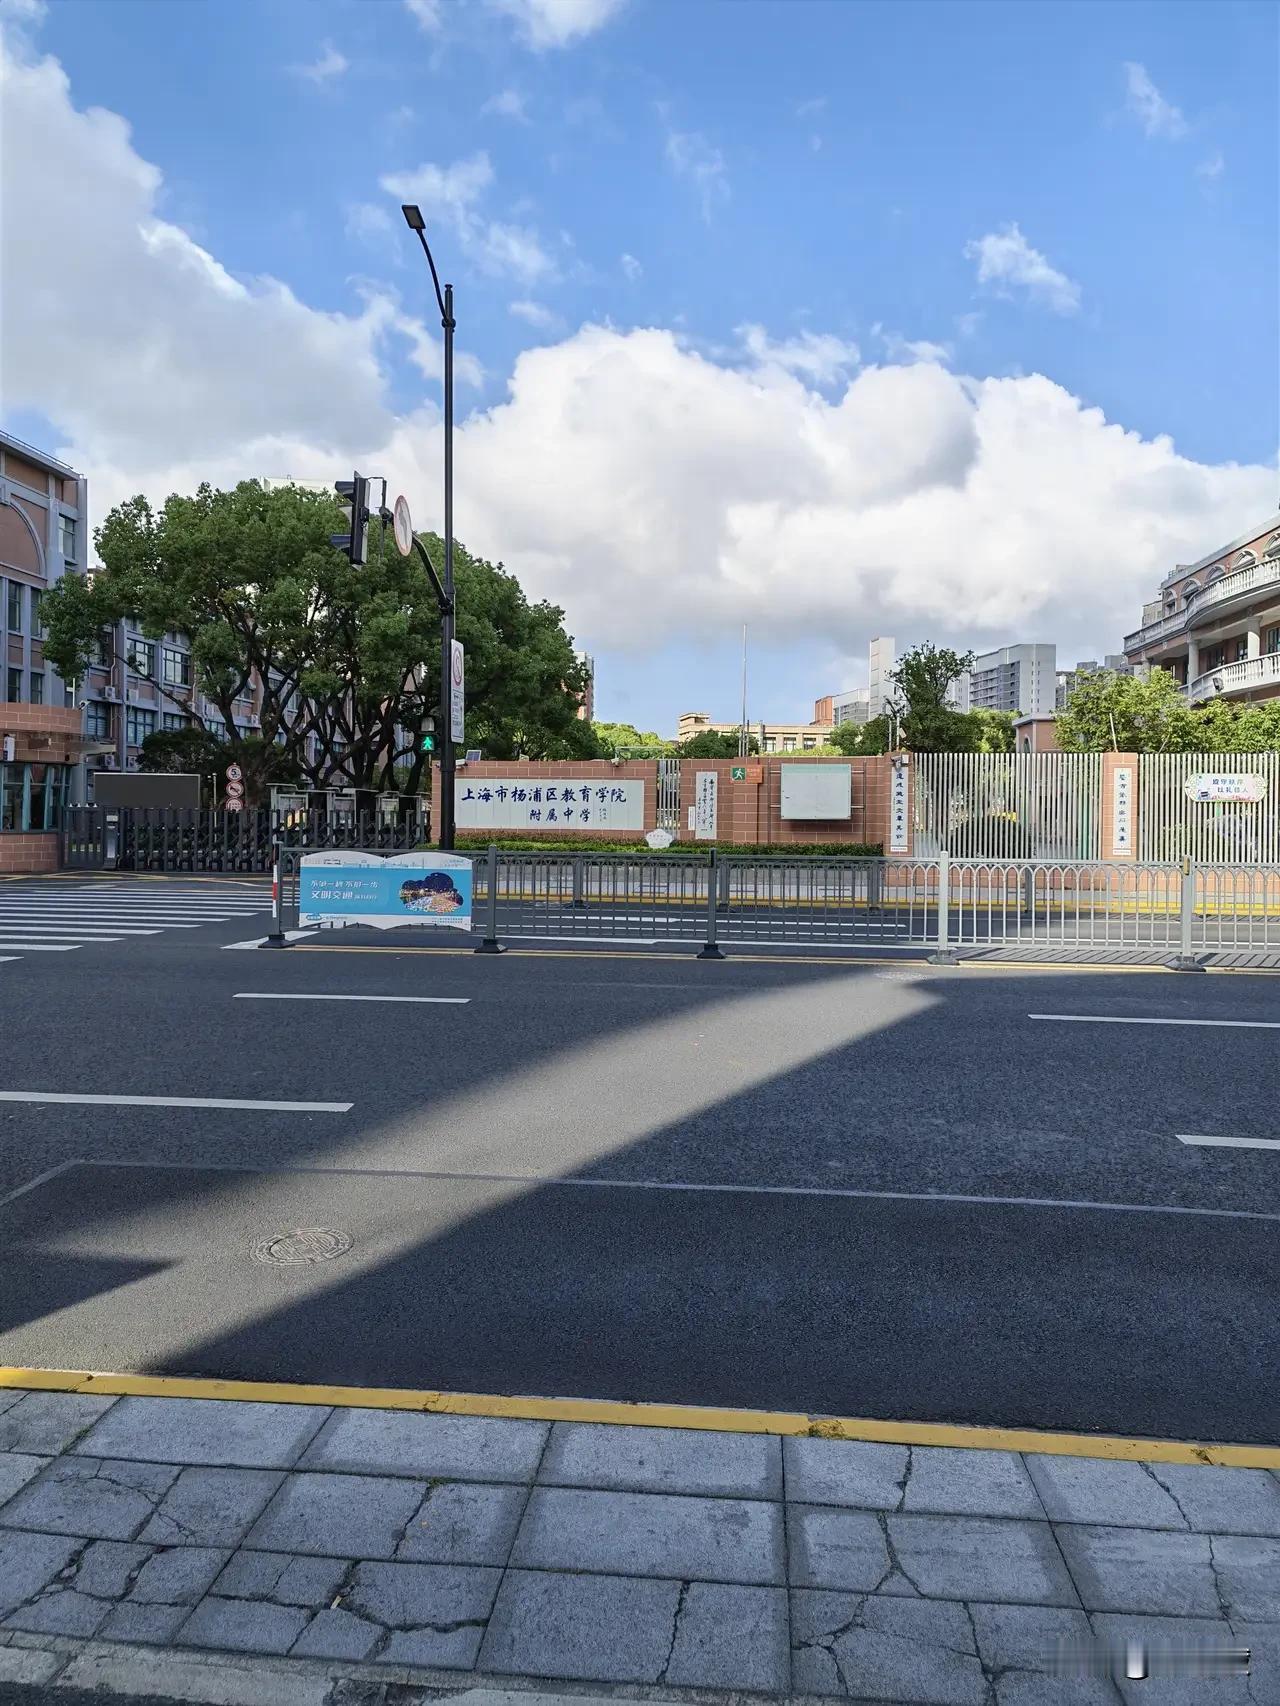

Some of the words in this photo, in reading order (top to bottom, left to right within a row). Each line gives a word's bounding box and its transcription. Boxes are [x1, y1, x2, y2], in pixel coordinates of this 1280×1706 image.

[461, 785, 627, 804] 上海市杨浦区教育学院
[529, 806, 591, 823] 附属中学
[311, 890, 353, 900] 文明交通
